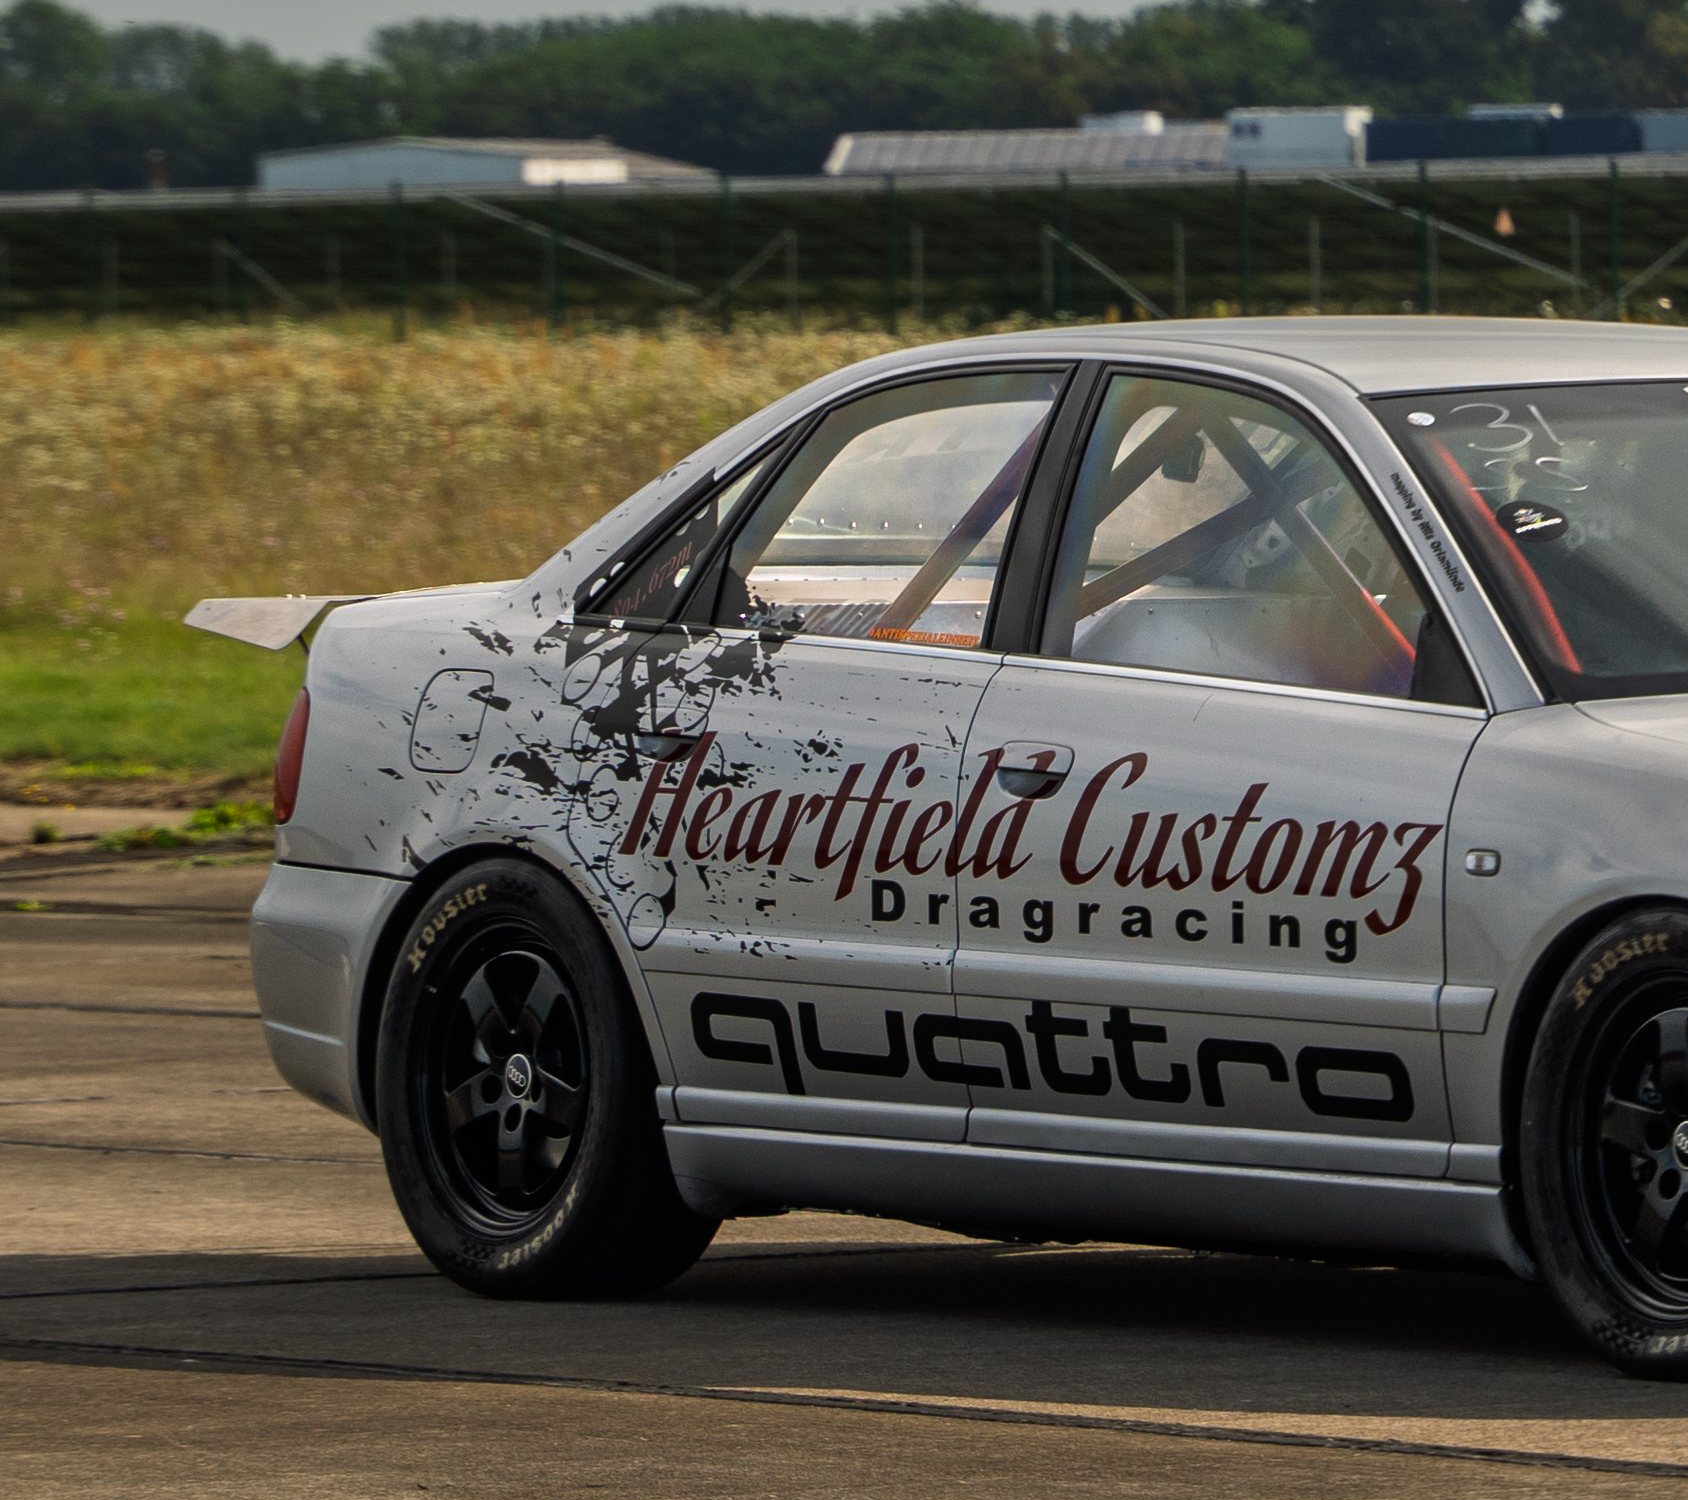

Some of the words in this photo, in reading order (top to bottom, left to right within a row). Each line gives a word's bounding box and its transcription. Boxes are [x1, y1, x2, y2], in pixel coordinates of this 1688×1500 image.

[1411, 508, 1423, 522] by
[618, 730, 1057, 901] Heartfield
[1059, 752, 1444, 936] Customz
[871, 879, 1358, 963] Dragracing
[690, 991, 1415, 1123] quattro
